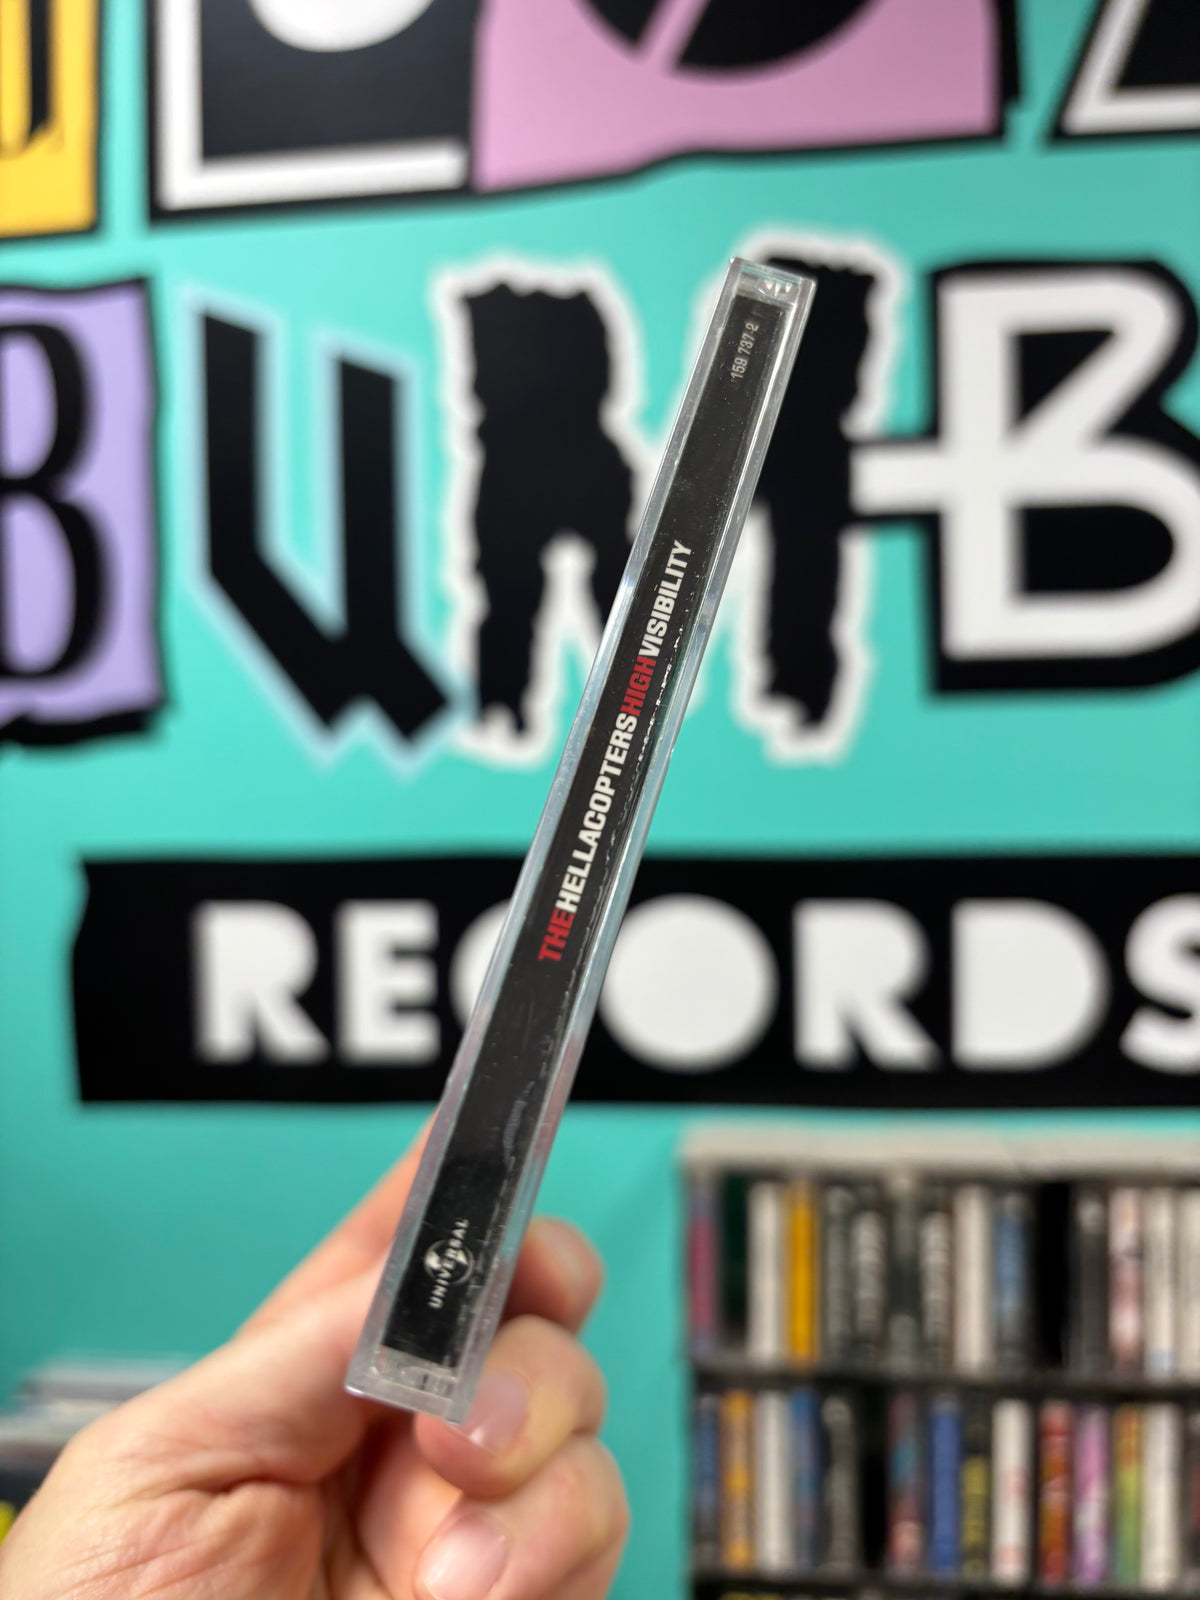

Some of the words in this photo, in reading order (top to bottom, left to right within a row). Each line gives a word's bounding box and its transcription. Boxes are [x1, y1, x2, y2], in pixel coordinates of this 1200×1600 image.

[730, 357, 748, 379] 159
[737, 322, 759, 356] 737-2
[196, 893, 1200, 1074] REORDS
[427, 1218, 470, 1310] UNIVERSAL
